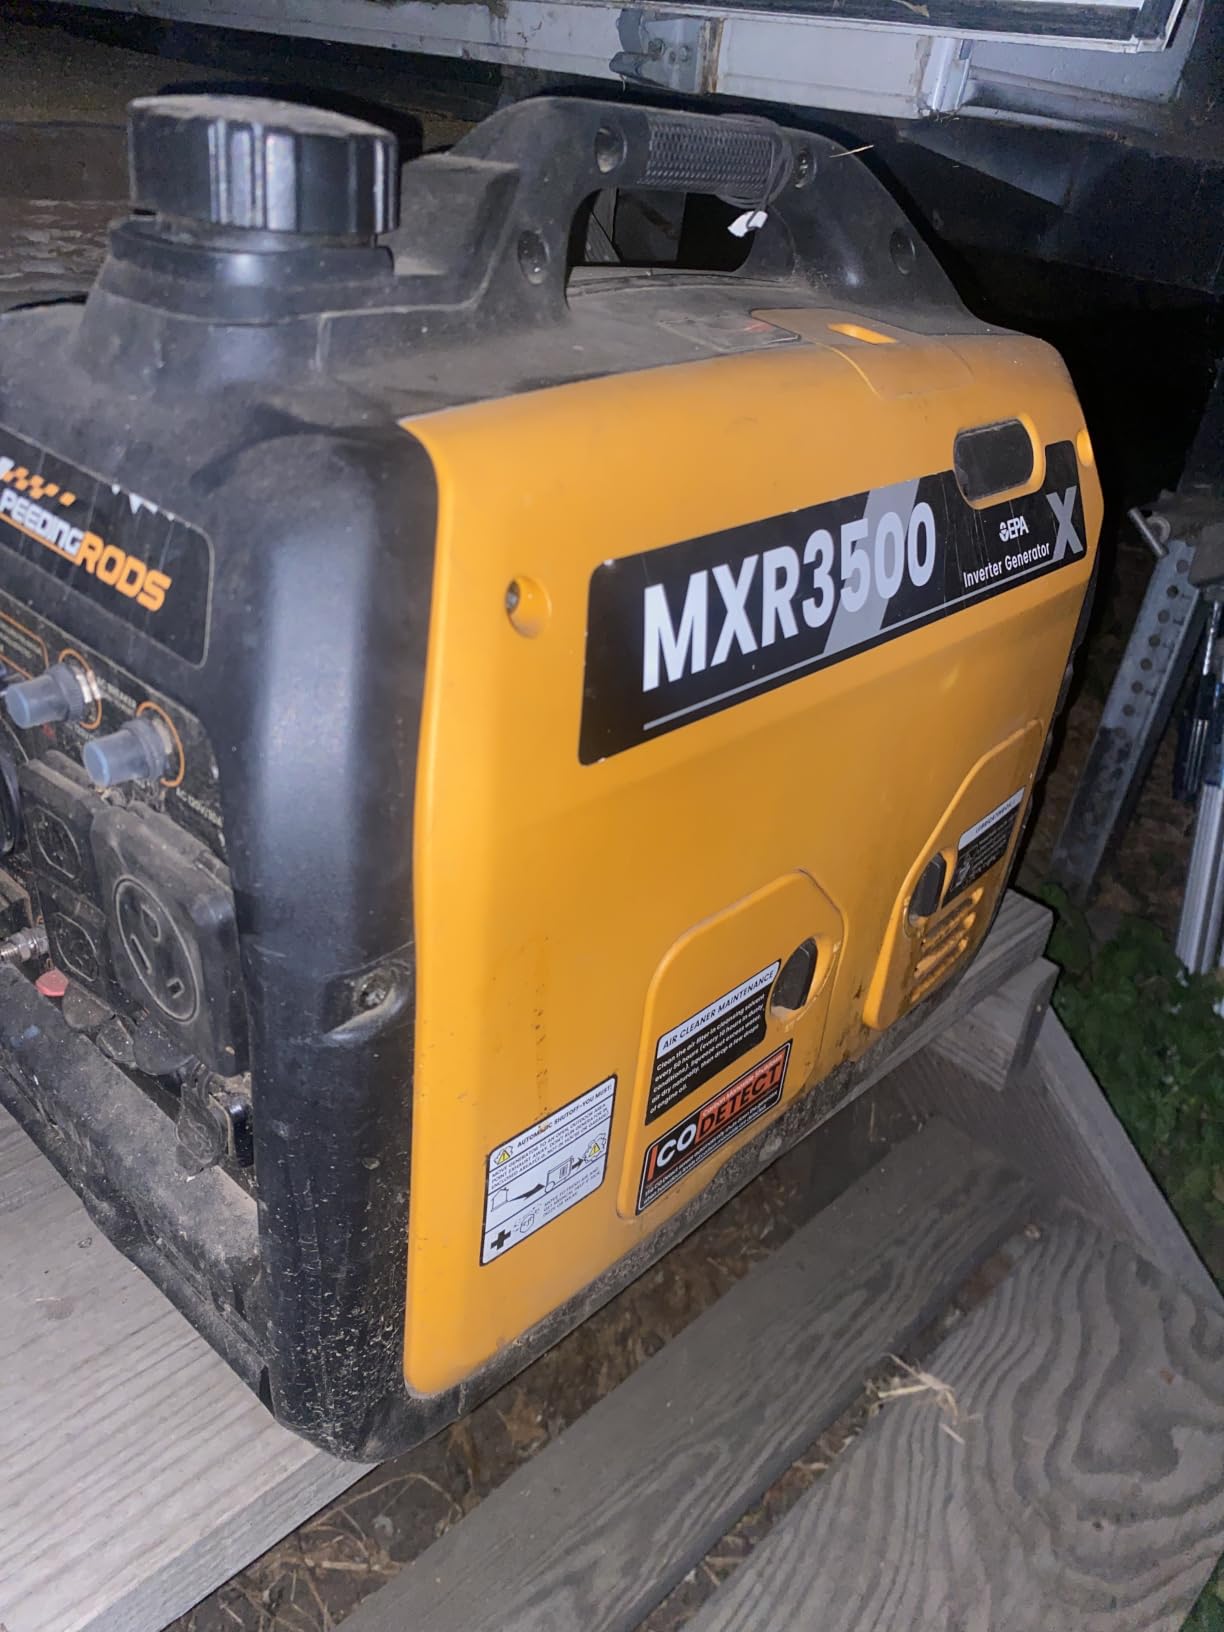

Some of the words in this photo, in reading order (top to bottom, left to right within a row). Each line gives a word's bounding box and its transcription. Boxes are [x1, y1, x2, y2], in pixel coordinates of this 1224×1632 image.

[1046, 485, 1084, 560] X
[643, 502, 936, 693] MXR3500
[963, 561, 1002, 588] Inverter
[1004, 542, 1050, 571] Generator
[656, 1055, 676, 1070] Clean
[676, 1047, 687, 1057] the
[744, 994, 765, 1010] solvent
[662, 1035, 678, 1050] AIR
[678, 1010, 716, 1039] CLEANER
[716, 971, 774, 1013] MAINTENANCE
[715, 1039, 725, 1048] out
[725, 1026, 744, 1041] excess
[655, 1067, 672, 1082] every
[673, 1061, 681, 1069] 50
[681, 1048, 699, 1063] hours
[725, 1019, 742, 1032] hours
[661, 1086, 671, 1096] dry
[700, 1056, 714, 1068] then
[714, 1046, 729, 1058] drop
[656, 1123, 697, 1168] CO
[699, 1060, 782, 1136] DETECT
[657, 1090, 678, 1107] engine
